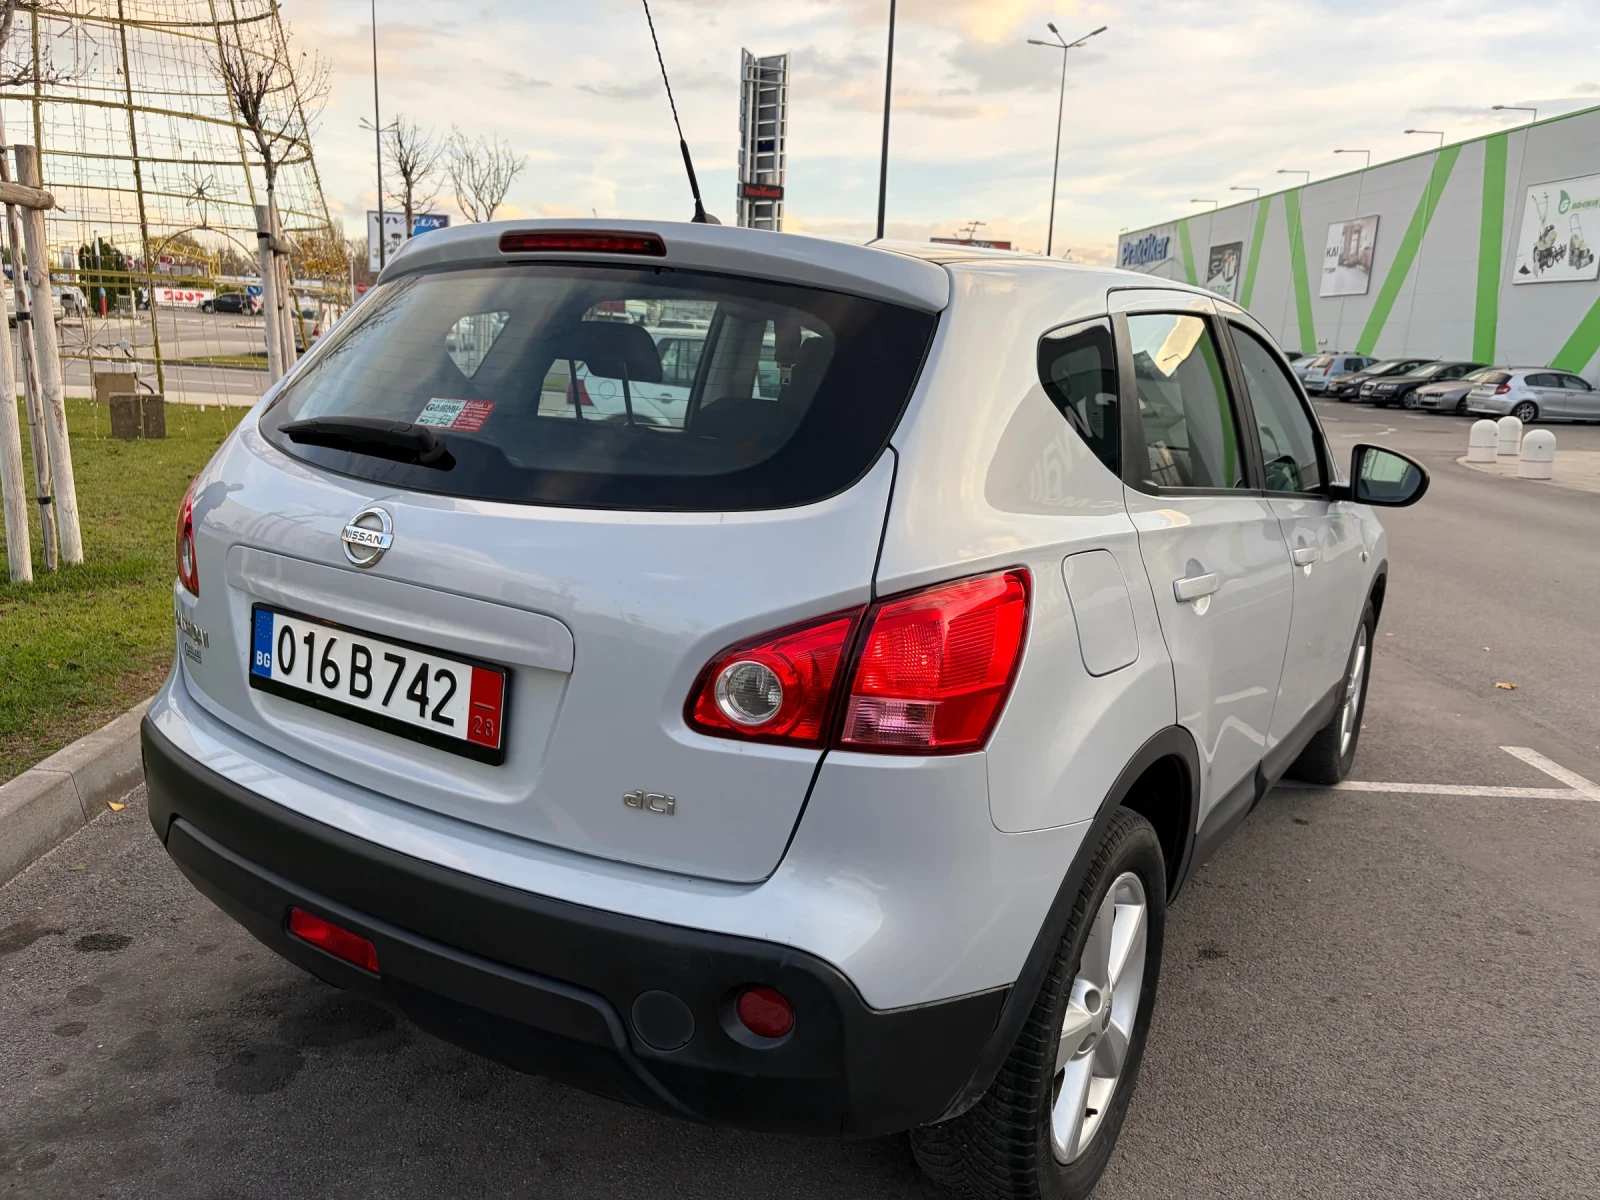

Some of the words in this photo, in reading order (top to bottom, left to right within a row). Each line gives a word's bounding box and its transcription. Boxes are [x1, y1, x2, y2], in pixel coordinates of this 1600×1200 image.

[1122, 233, 1170, 266] Praktiker
[344, 529, 384, 545] NISSAN
[256, 650, 271, 668] BG
[473, 715, 495, 738] 28
[623, 789, 675, 816] dCi
